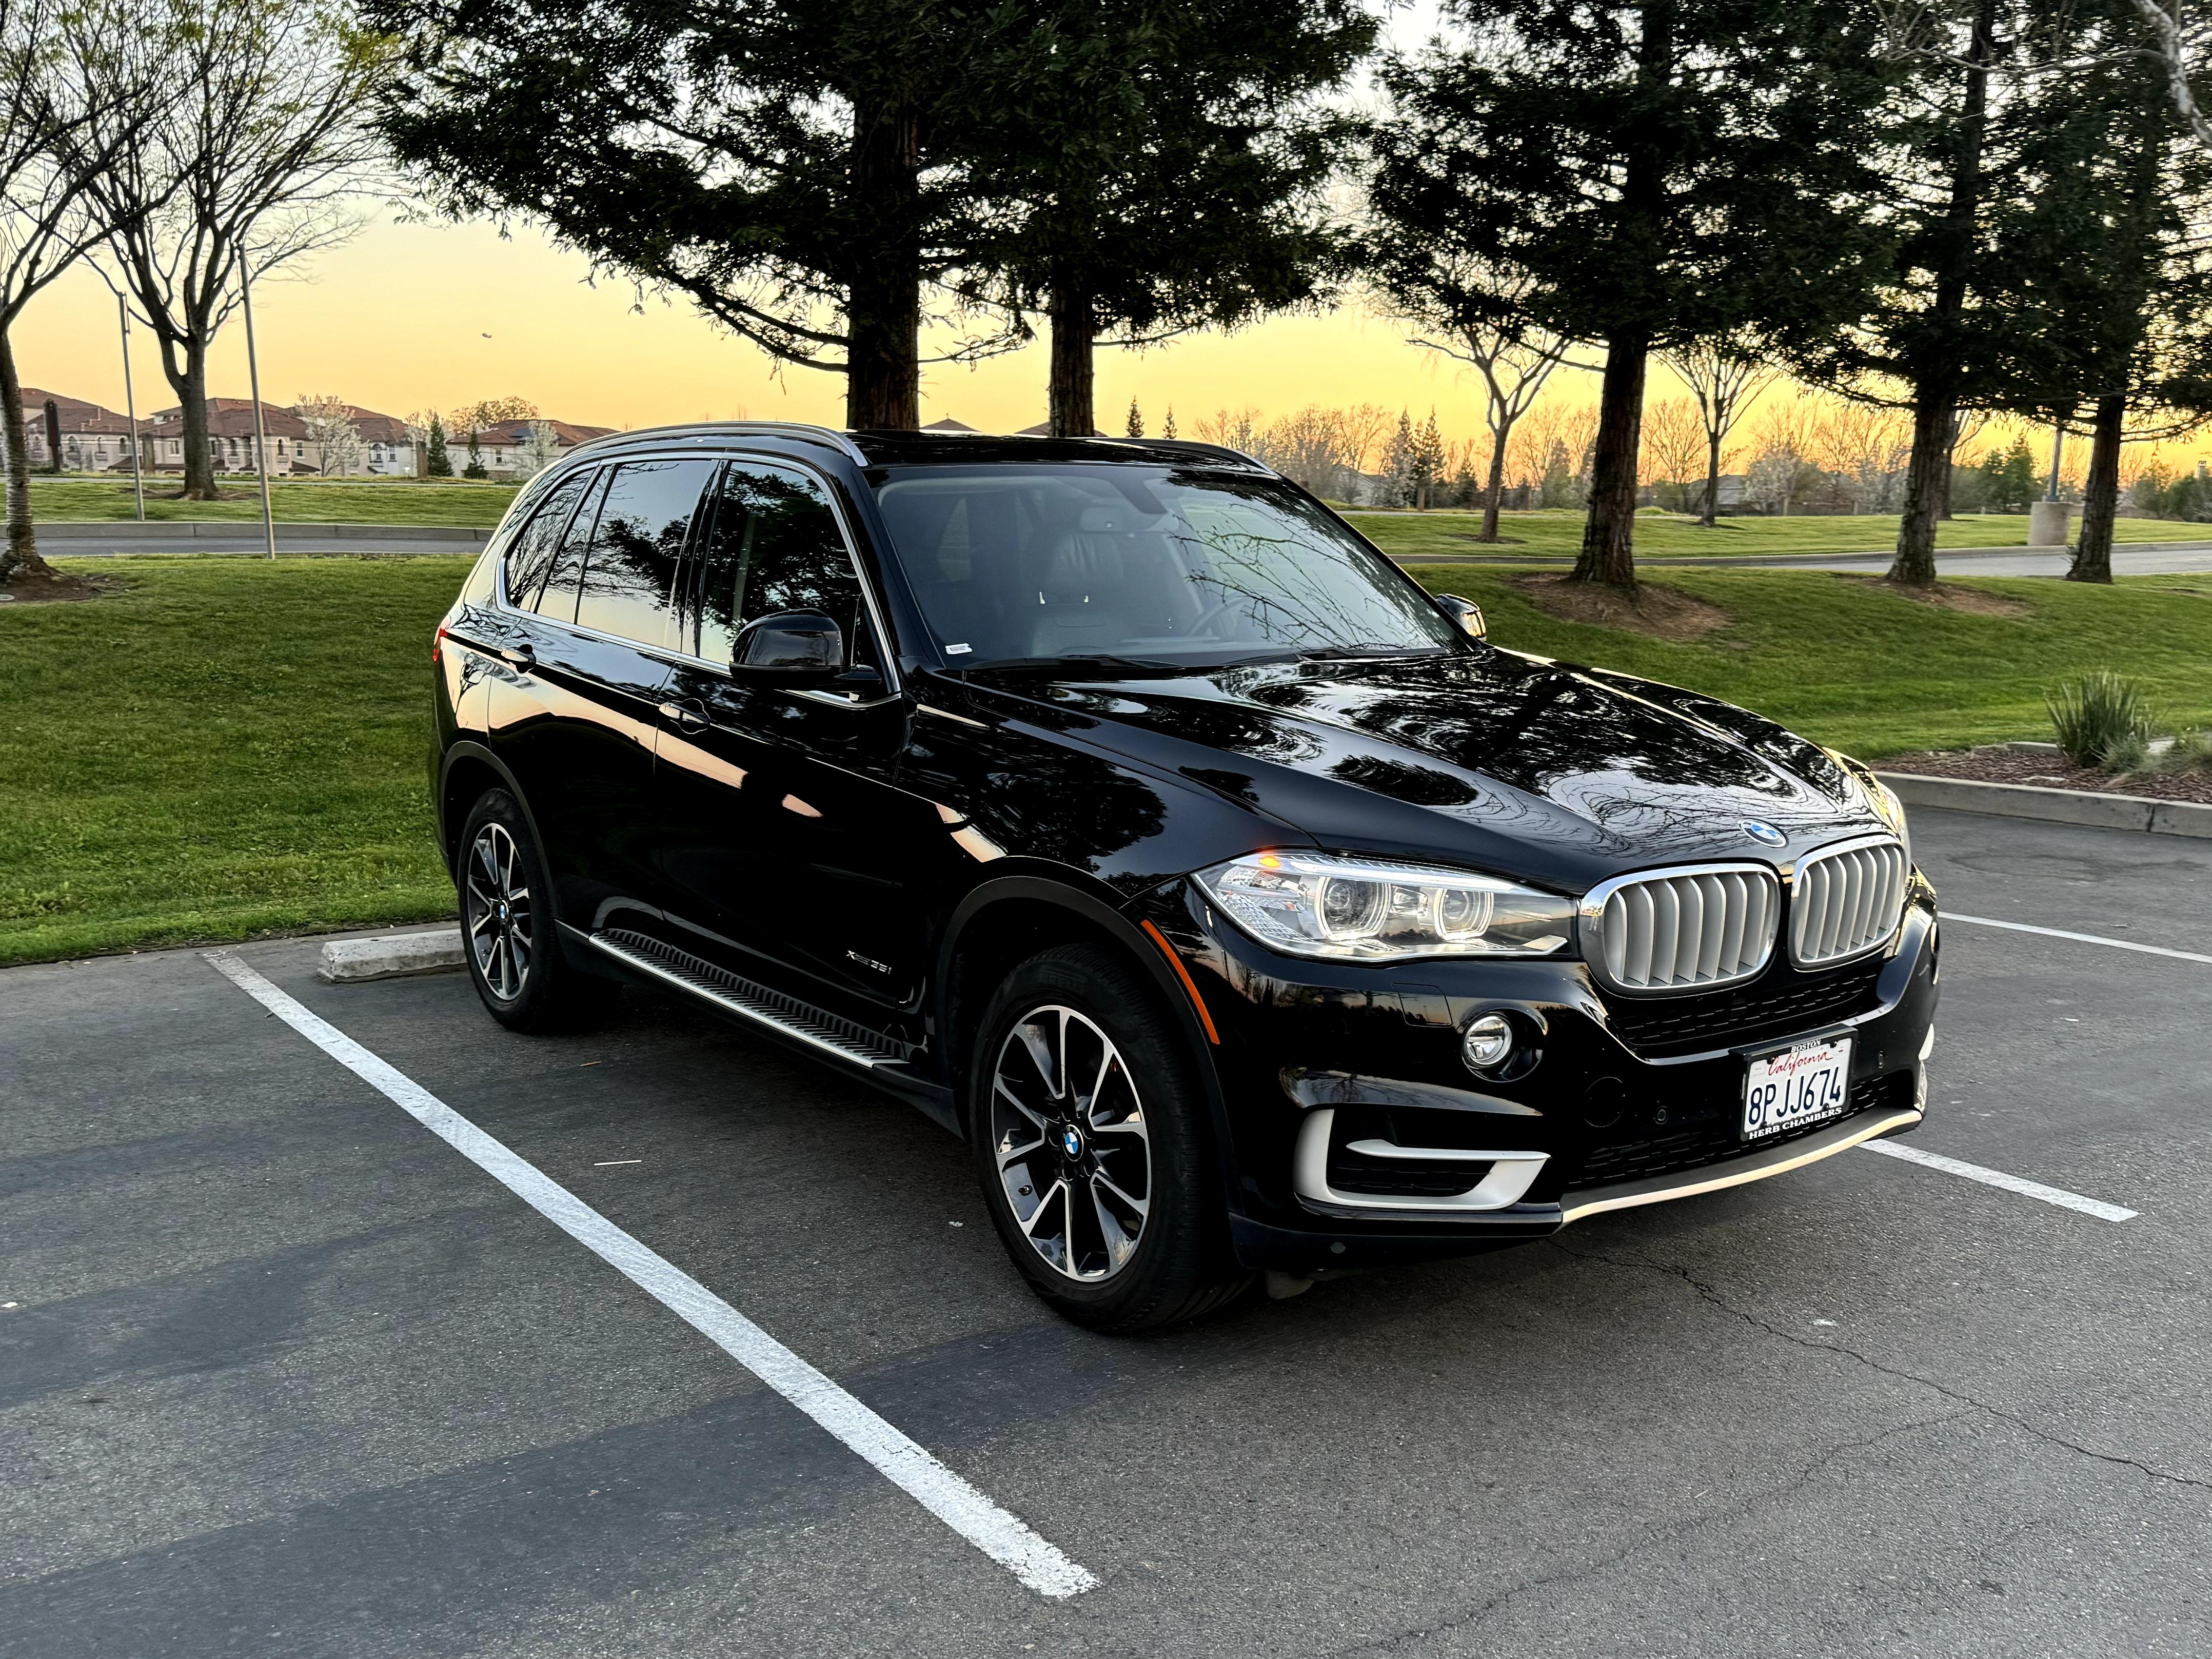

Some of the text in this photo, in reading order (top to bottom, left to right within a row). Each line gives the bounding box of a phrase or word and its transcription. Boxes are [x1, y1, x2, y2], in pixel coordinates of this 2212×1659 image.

[1791, 1039, 1820, 1052] BOSTON
[1768, 1052, 1833, 1076] California
[1749, 1066, 1841, 1125] 8PJJ674
[1749, 1107, 1842, 1139] HERB CHAMBERS
